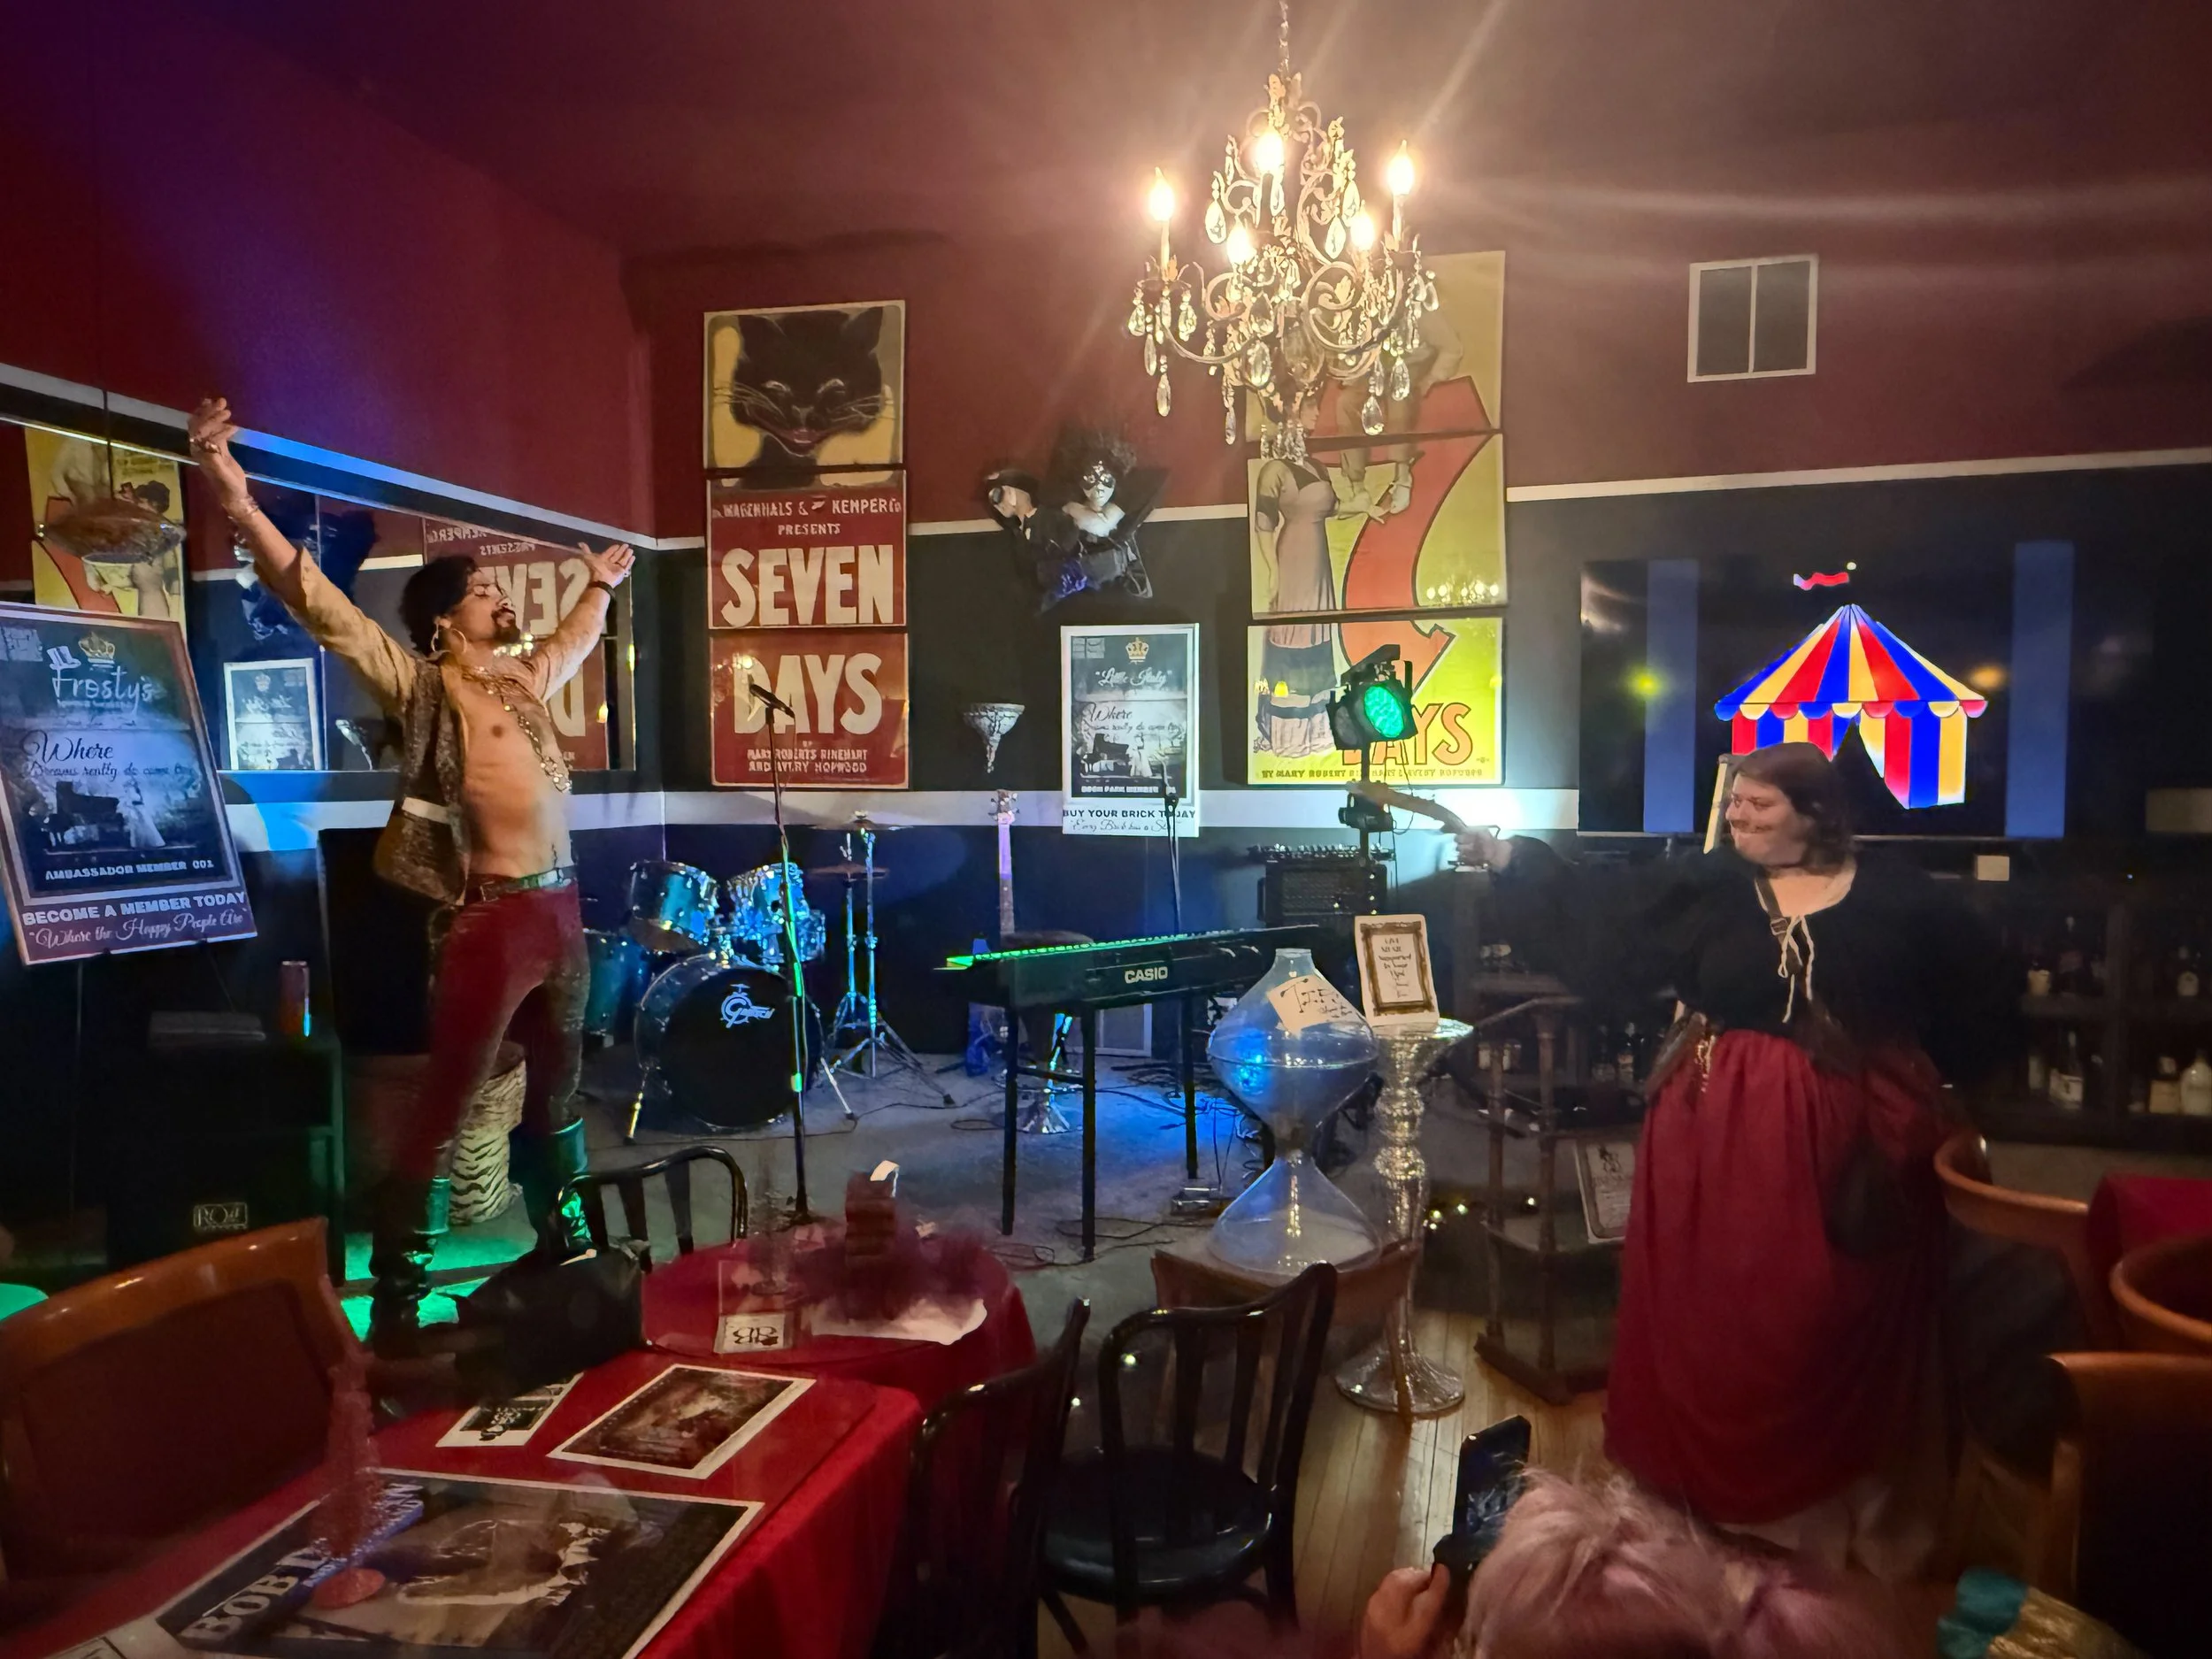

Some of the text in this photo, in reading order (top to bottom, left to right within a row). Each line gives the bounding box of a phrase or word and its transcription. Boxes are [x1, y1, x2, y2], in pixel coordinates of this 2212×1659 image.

[778, 523, 841, 535] PRESENTS
[720, 544, 894, 627] SEVEN
[51, 665, 154, 715] Frosty's
[733, 653, 882, 735] DAYS
[21, 730, 114, 763] Where
[774, 749, 817, 761] ROBERTS
[820, 749, 868, 761] RINEHART
[748, 762, 772, 772] AND
[814, 762, 868, 773] HOPWOOD
[45, 865, 134, 880] AMBASSADOR
[136, 861, 187, 873] MEMBER
[22, 891, 247, 926] BECOME A MEMBER TODAY
[116, 917, 172, 941] Happy
[173, 912, 218, 933] People
[1125, 966, 1168, 984] CASIO
[179, 1572, 300, 1640] BOB
